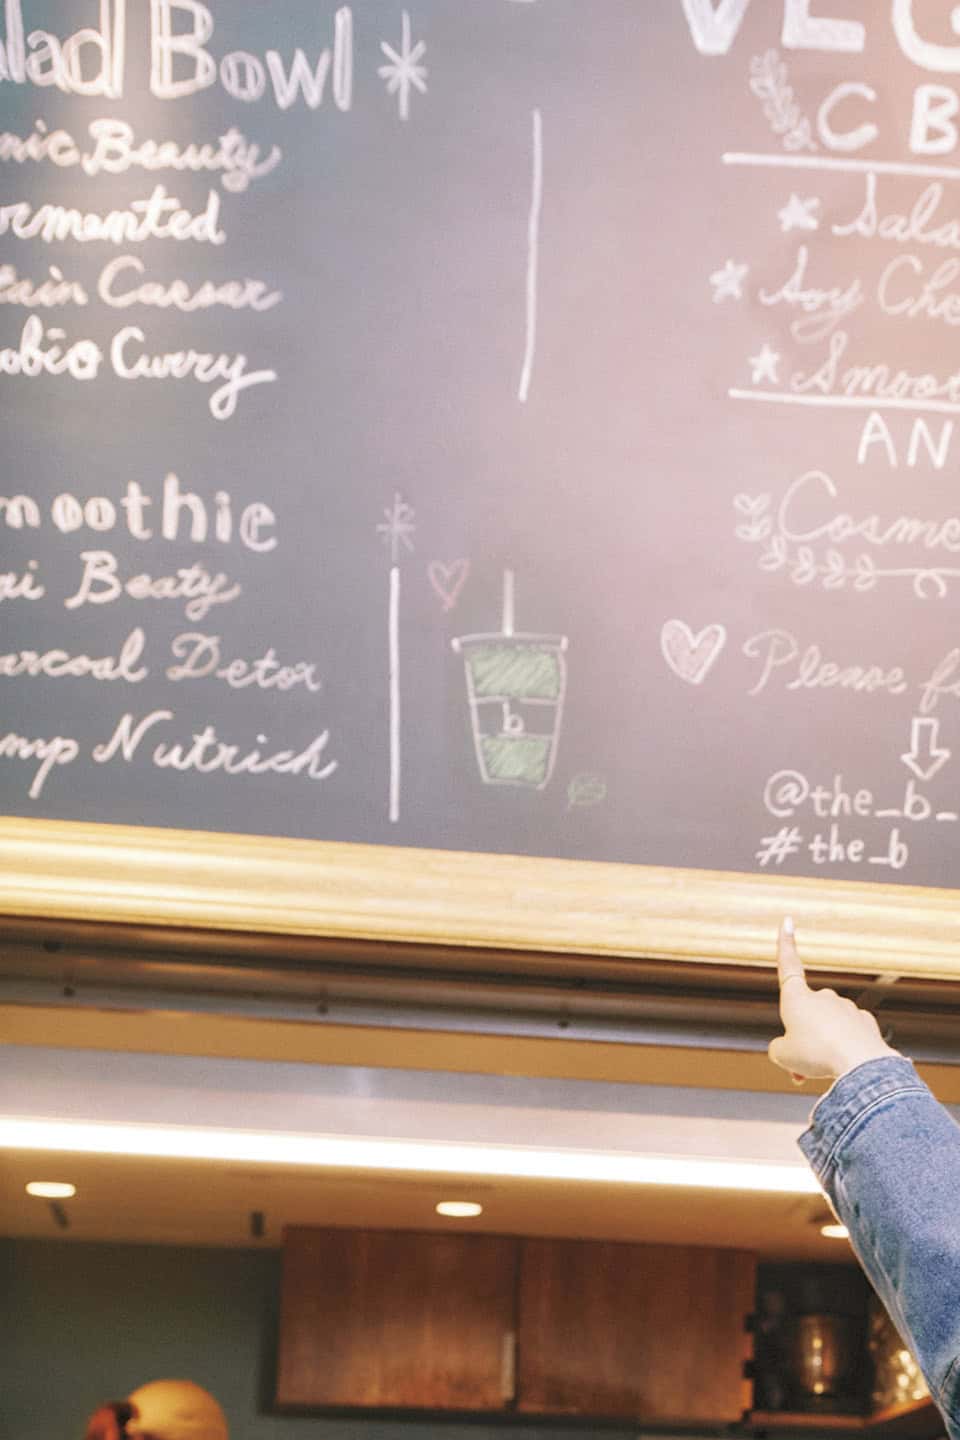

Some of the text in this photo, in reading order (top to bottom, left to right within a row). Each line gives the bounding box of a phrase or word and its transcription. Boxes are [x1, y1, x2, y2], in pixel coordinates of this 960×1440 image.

[0, 0, 354, 112] lad Bowl
[758, 244, 863, 341] Soy
[110, 326, 278, 420] Curry
[0, 472, 278, 552] moothie
[165, 632, 321, 691] Detox
[742, 629, 908, 696] Please
